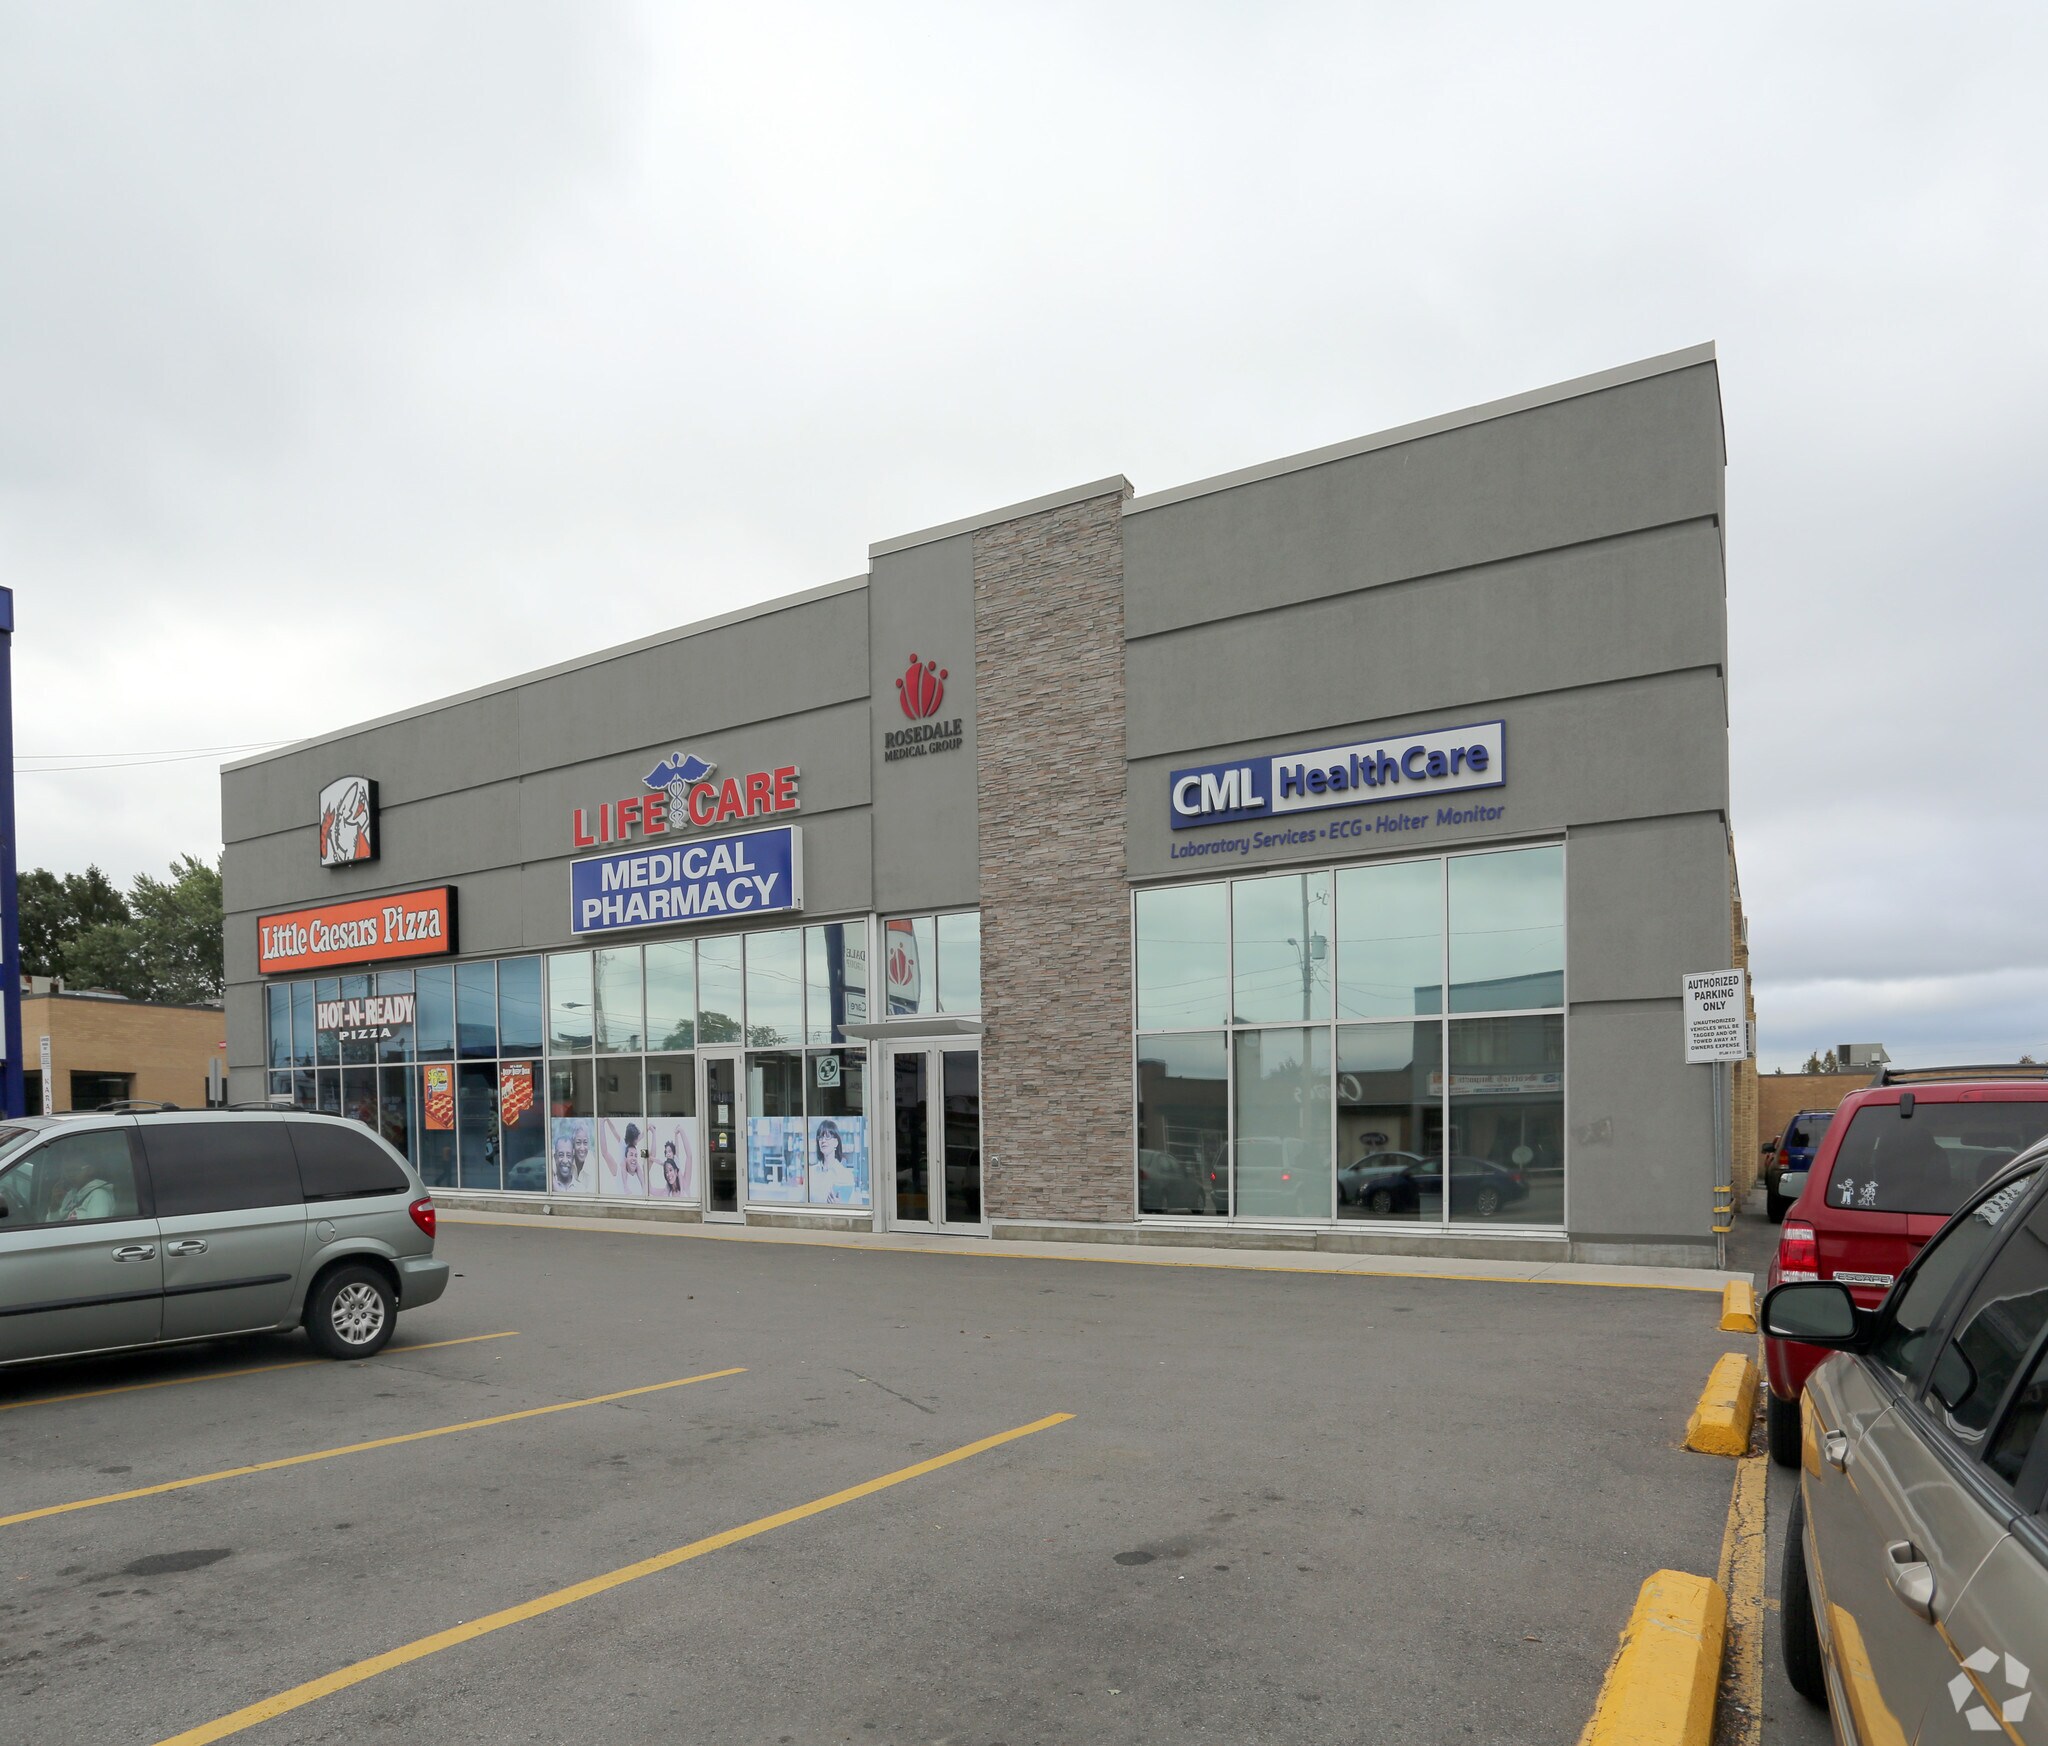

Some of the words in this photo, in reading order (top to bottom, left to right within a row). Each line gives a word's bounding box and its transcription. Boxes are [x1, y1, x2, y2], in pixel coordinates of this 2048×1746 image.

[884, 718, 962, 749] ROSEDALE
[884, 744, 927, 762] MEDICAL
[929, 738, 962, 753] GROUP
[1172, 767, 1265, 817] CML
[1279, 744, 1490, 799] HealthCare
[572, 791, 669, 848] LIFE
[688, 765, 800, 827] CARE
[1170, 837, 1250, 859] Laboratory
[1252, 829, 1317, 849] Services
[1328, 818, 1362, 840] ECG
[1375, 813, 1429, 833] Holter
[1436, 805, 1505, 826] Monitor
[601, 841, 756, 892] MEDICAL
[582, 872, 779, 928] PHARMACY
[262, 922, 308, 960] Little
[309, 916, 378, 954] Caesars
[382, 905, 442, 944] Pizza
[1688, 975, 1739, 990] AUTHORIZED
[1694, 988, 1734, 1001] PARKING
[317, 994, 415, 1030] HOT-N-READY
[1693, 1017, 1736, 1026] UNAUTHORIZED
[1702, 1001, 1726, 1012] ONLY
[339, 1027, 392, 1041] PIZZA
[1836, 1272, 1890, 1284] ESCAPE
